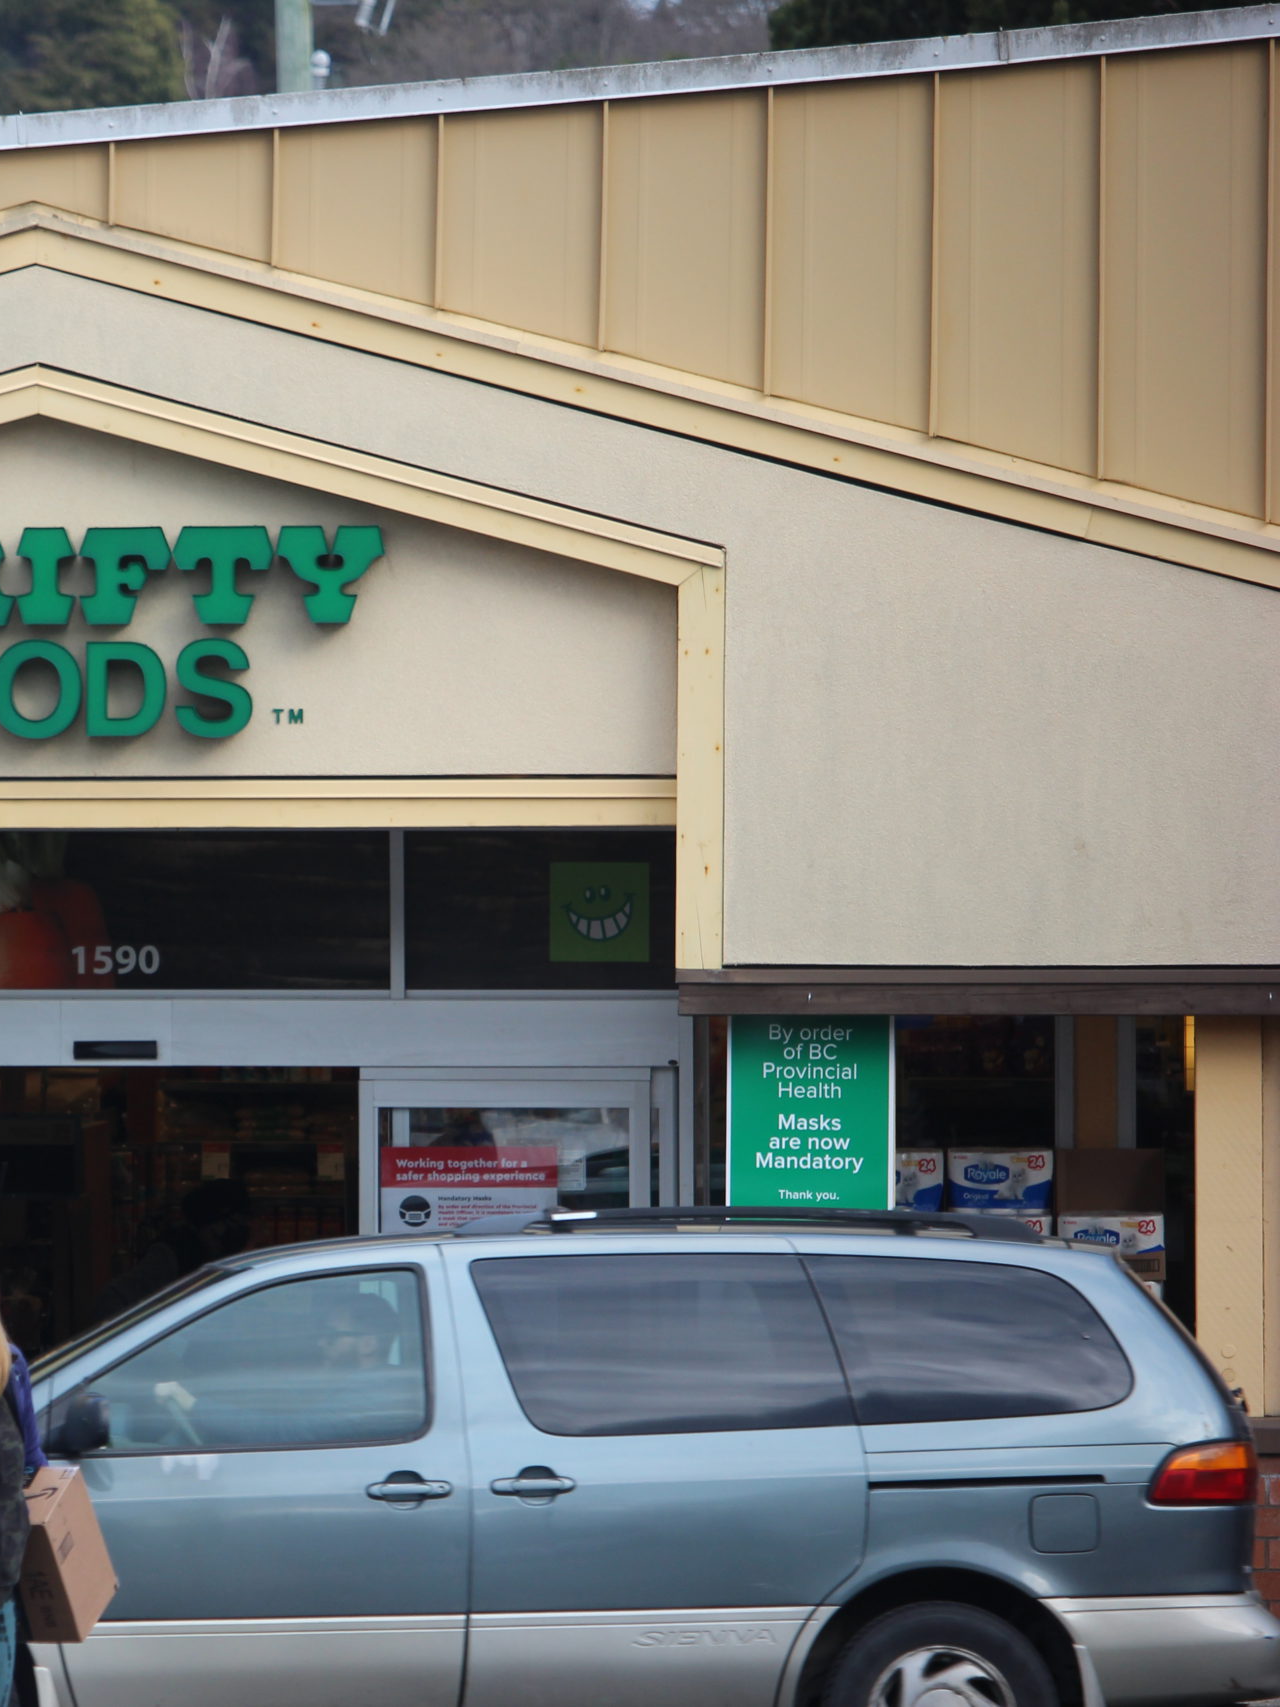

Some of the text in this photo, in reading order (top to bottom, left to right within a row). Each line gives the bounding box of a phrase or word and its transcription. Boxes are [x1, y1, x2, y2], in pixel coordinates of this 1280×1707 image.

[272, 708, 305, 726] TM
[71, 945, 160, 975] 1590
[769, 1024, 853, 1043] By order
[783, 1043, 838, 1060] of BC
[762, 1062, 858, 1080] Provincial
[777, 1082, 842, 1099] Health
[778, 1114, 842, 1131] Masks
[769, 1136, 850, 1150] are now
[395, 1158, 445, 1170] Working
[447, 1159, 498, 1170] together
[500, 1159, 517, 1168] for
[755, 1152, 863, 1174] Mandatory
[919, 1158, 936, 1173] 24
[1028, 1154, 1045, 1168] 24
[396, 1170, 546, 1182] safer shopping experience
[967, 1168, 1006, 1182] Royale
[778, 1190, 840, 1201] Thank you.
[1138, 1220, 1156, 1234] 24
[631, 1628, 777, 1649] SIENNA
